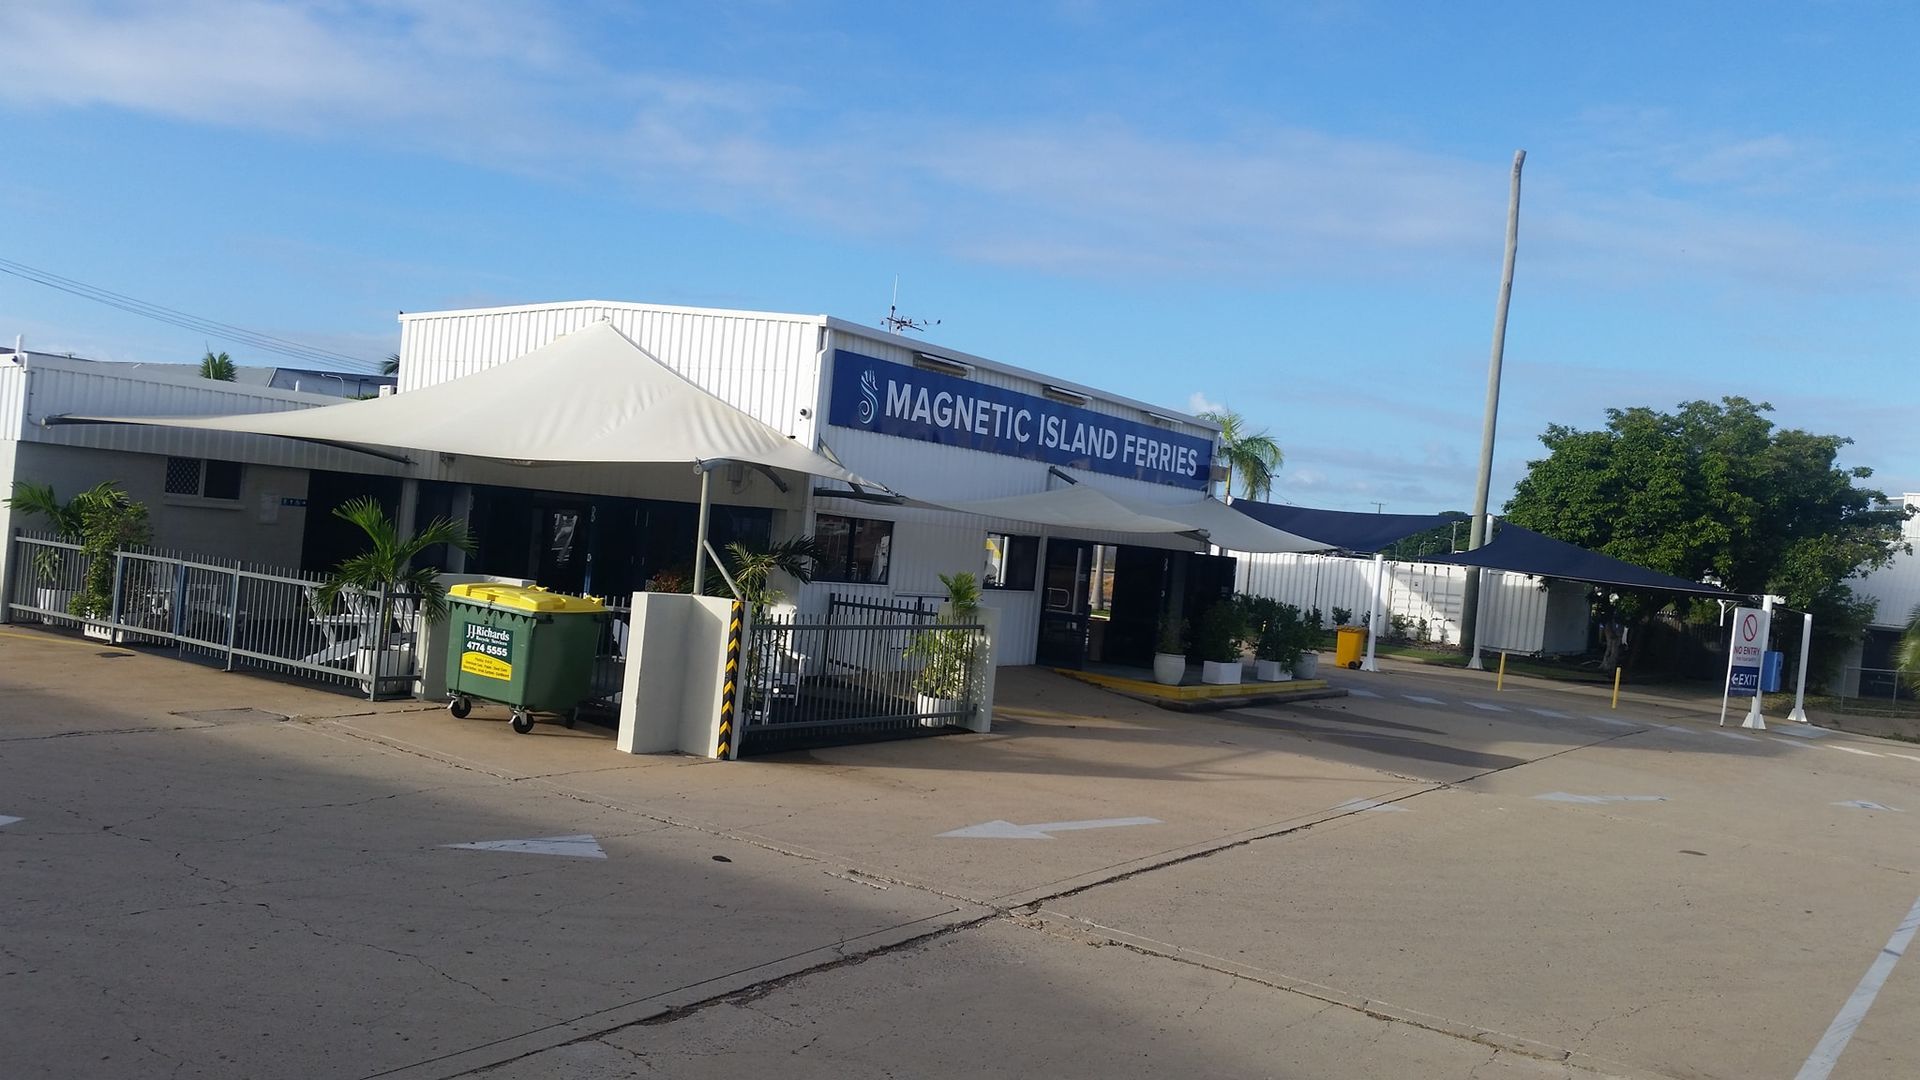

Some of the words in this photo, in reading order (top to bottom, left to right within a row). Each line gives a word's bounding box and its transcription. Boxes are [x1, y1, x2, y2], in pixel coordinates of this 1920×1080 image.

[885, 379, 1032, 443] MAGNETIC
[1038, 413, 1118, 461] ISLAND
[1122, 433, 1199, 477] FERRIES
[466, 641, 485, 652] 4774
[486, 645, 508, 656] 5555
[1734, 646, 1742, 655] NO
[1743, 646, 1760, 655] ENTRY
[1738, 673, 1757, 686] EXIT
